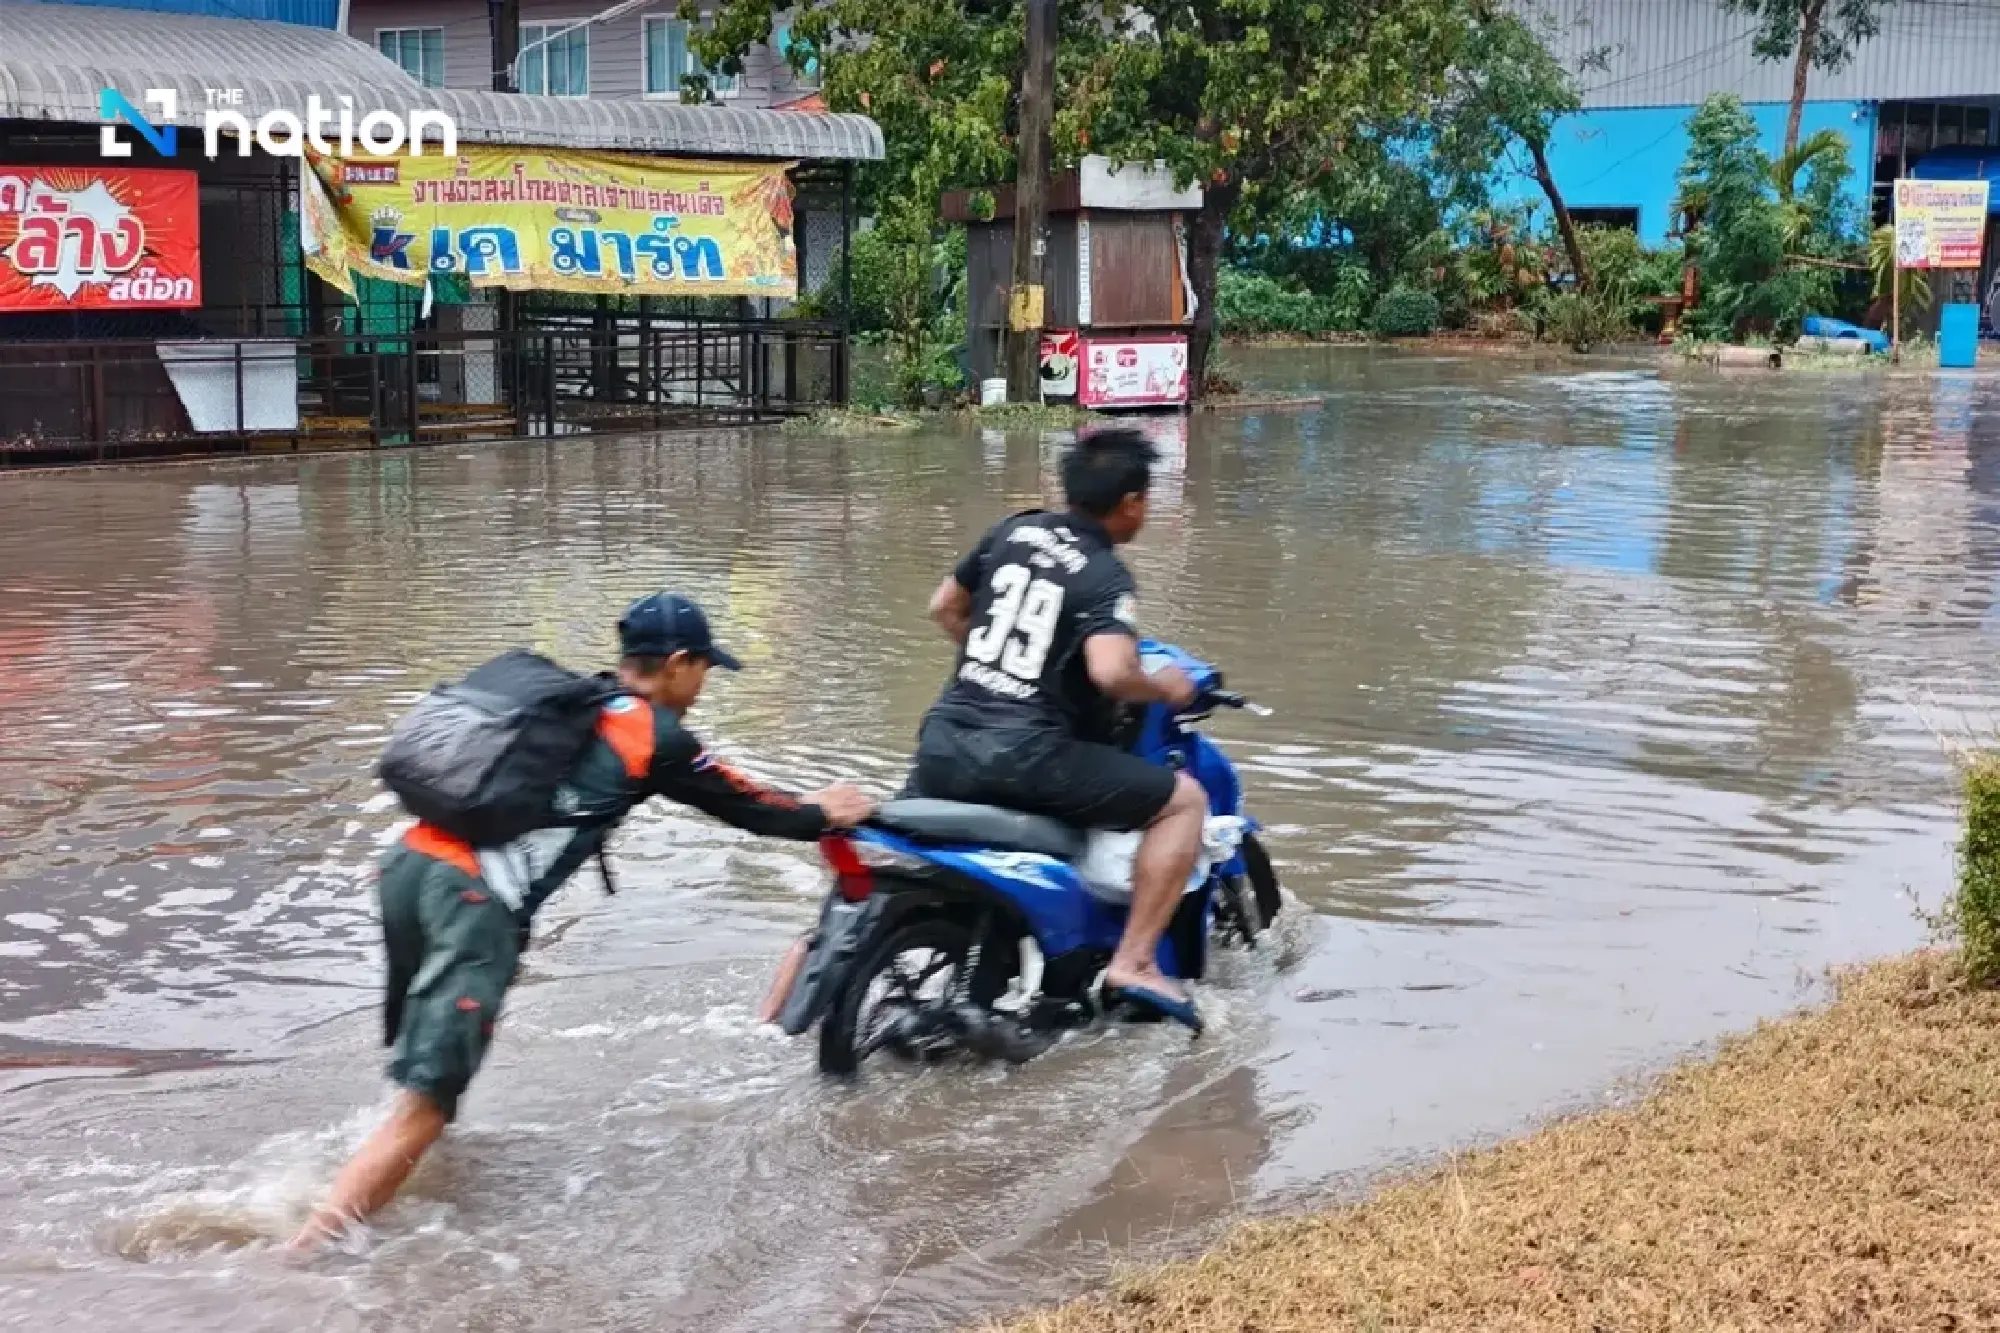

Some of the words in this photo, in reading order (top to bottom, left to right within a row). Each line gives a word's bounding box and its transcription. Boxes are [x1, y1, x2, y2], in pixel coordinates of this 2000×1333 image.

[16, 193, 145, 273] ล้าง
[429, 225, 522, 274] เค
[549, 213, 726, 281] มาร์ท
[966, 562, 1065, 680] 39
